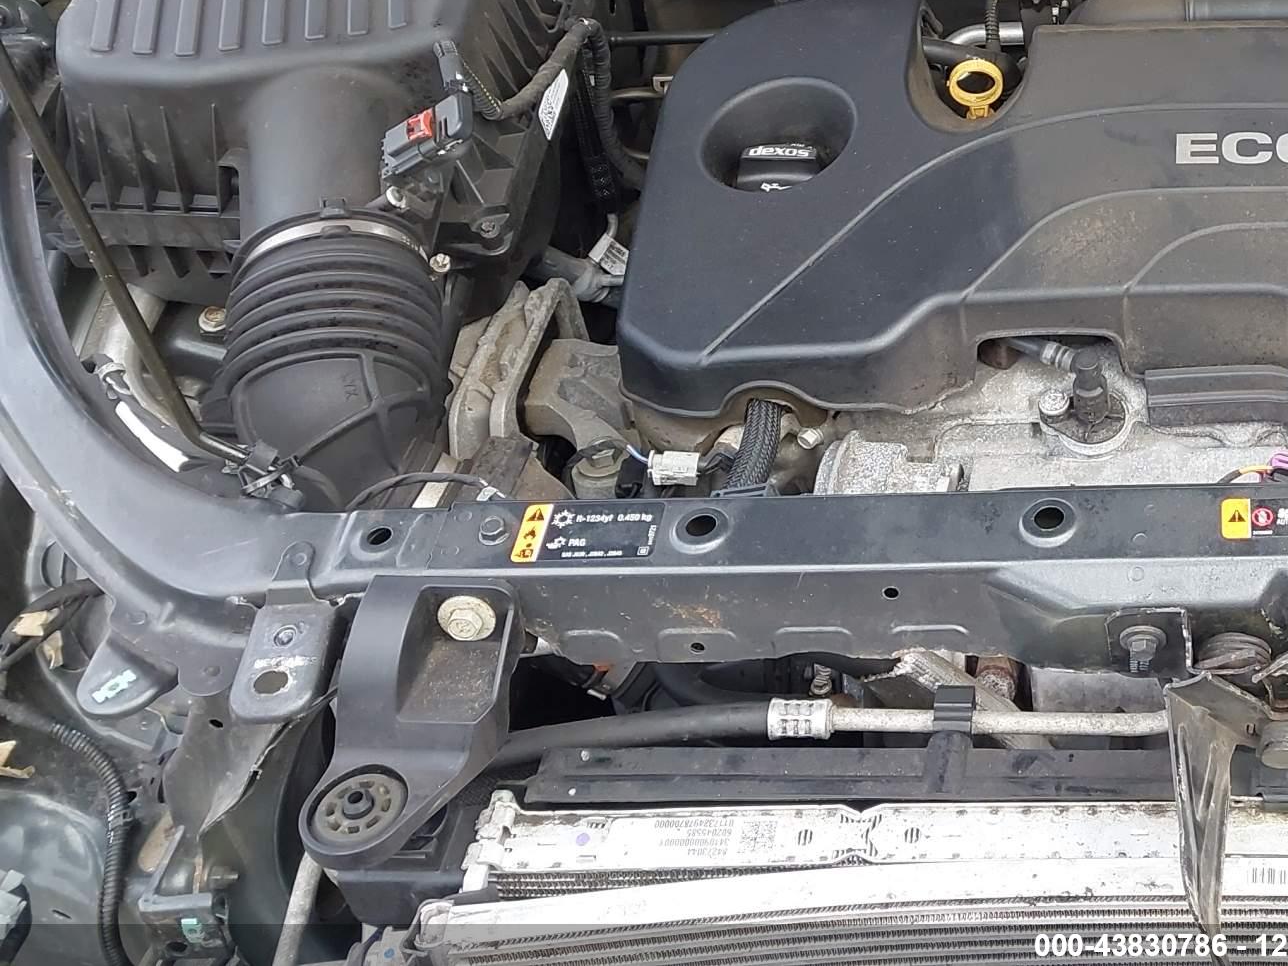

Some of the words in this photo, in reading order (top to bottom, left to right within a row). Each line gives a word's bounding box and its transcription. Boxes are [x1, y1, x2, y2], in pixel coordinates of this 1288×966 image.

[748, 145, 809, 157] dexos
[641, 514, 653, 522] kg
[568, 538, 586, 546] PAG
